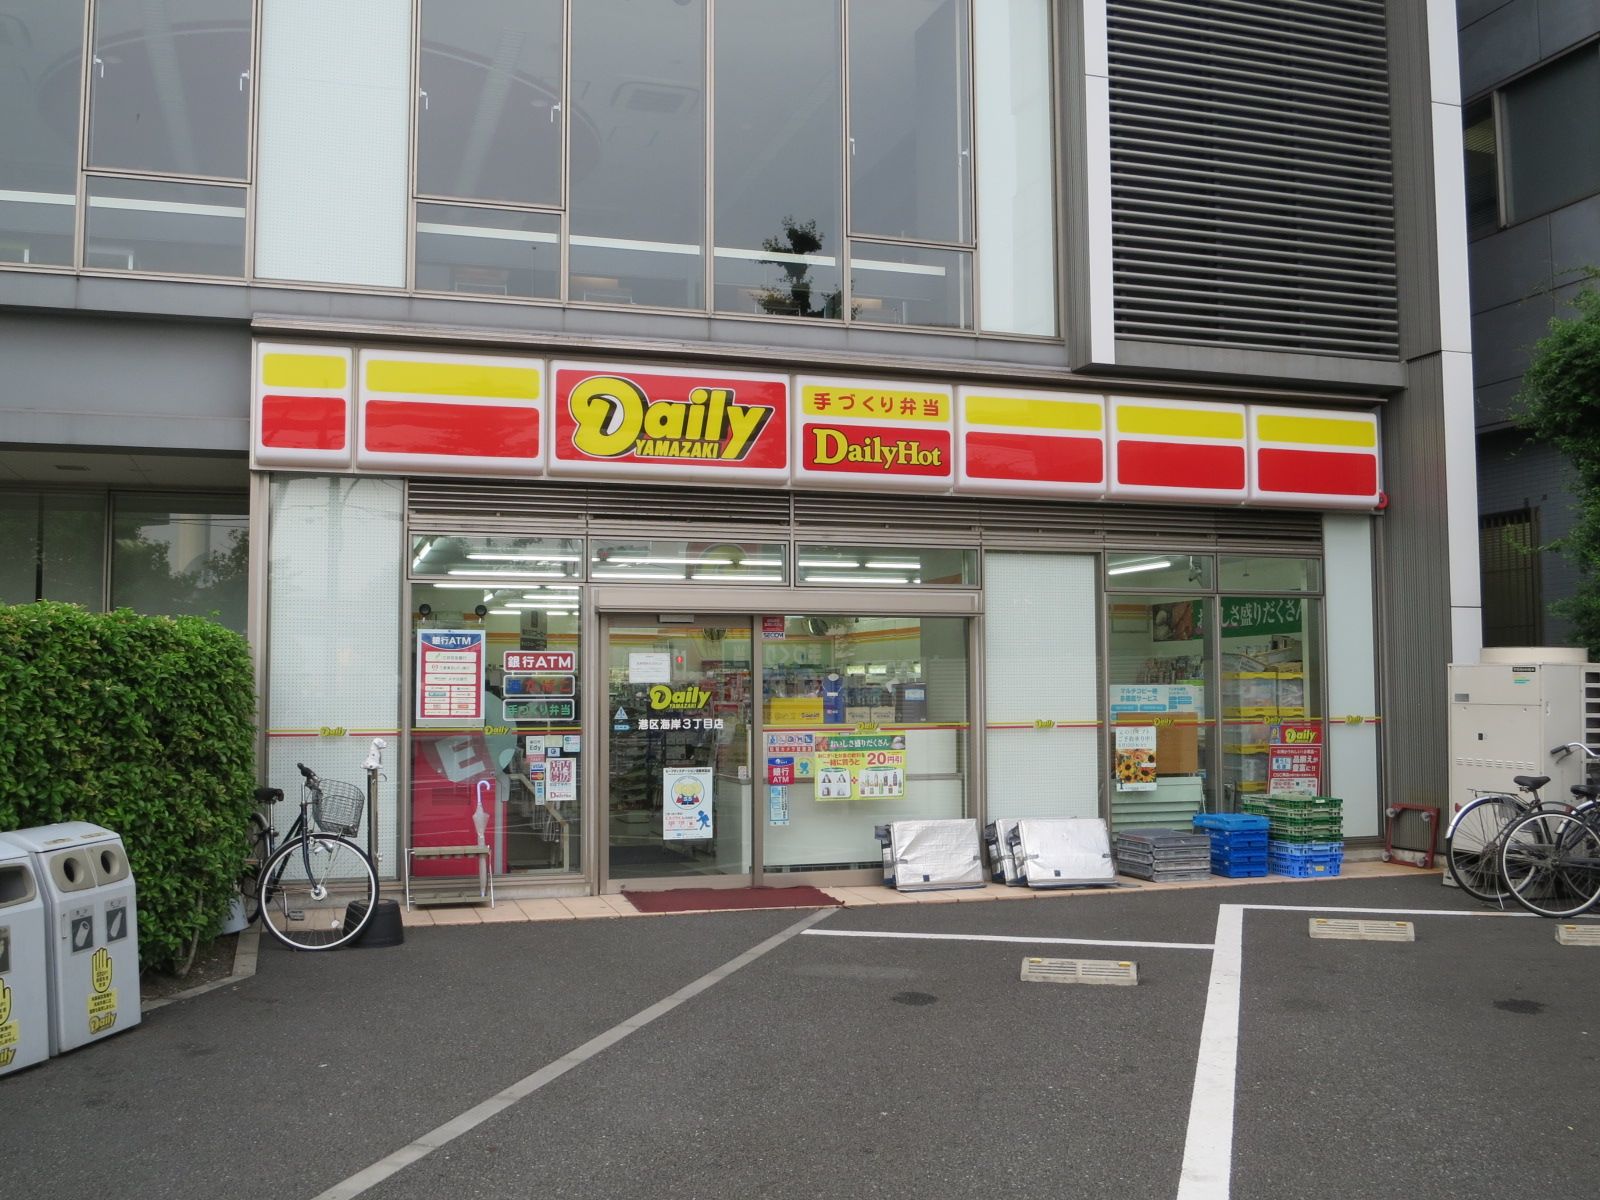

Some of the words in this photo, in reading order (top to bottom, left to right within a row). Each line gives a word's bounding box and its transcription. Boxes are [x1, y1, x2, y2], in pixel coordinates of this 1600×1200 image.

[813, 392, 940, 417] 手づくり弁当
[570, 376, 772, 459] Daily
[634, 438, 721, 460] YAMAZAKI
[812, 427, 942, 469] DailyHot
[431, 636, 471, 646] 銀行ATM
[507, 655, 572, 669] 銀行ATM
[650, 685, 712, 710] Daily
[485, 726, 511, 736] Daily
[1285, 728, 1318, 744] Daily
[773, 767, 790, 776] 銀行
[89, 1012, 117, 1034] Daily
